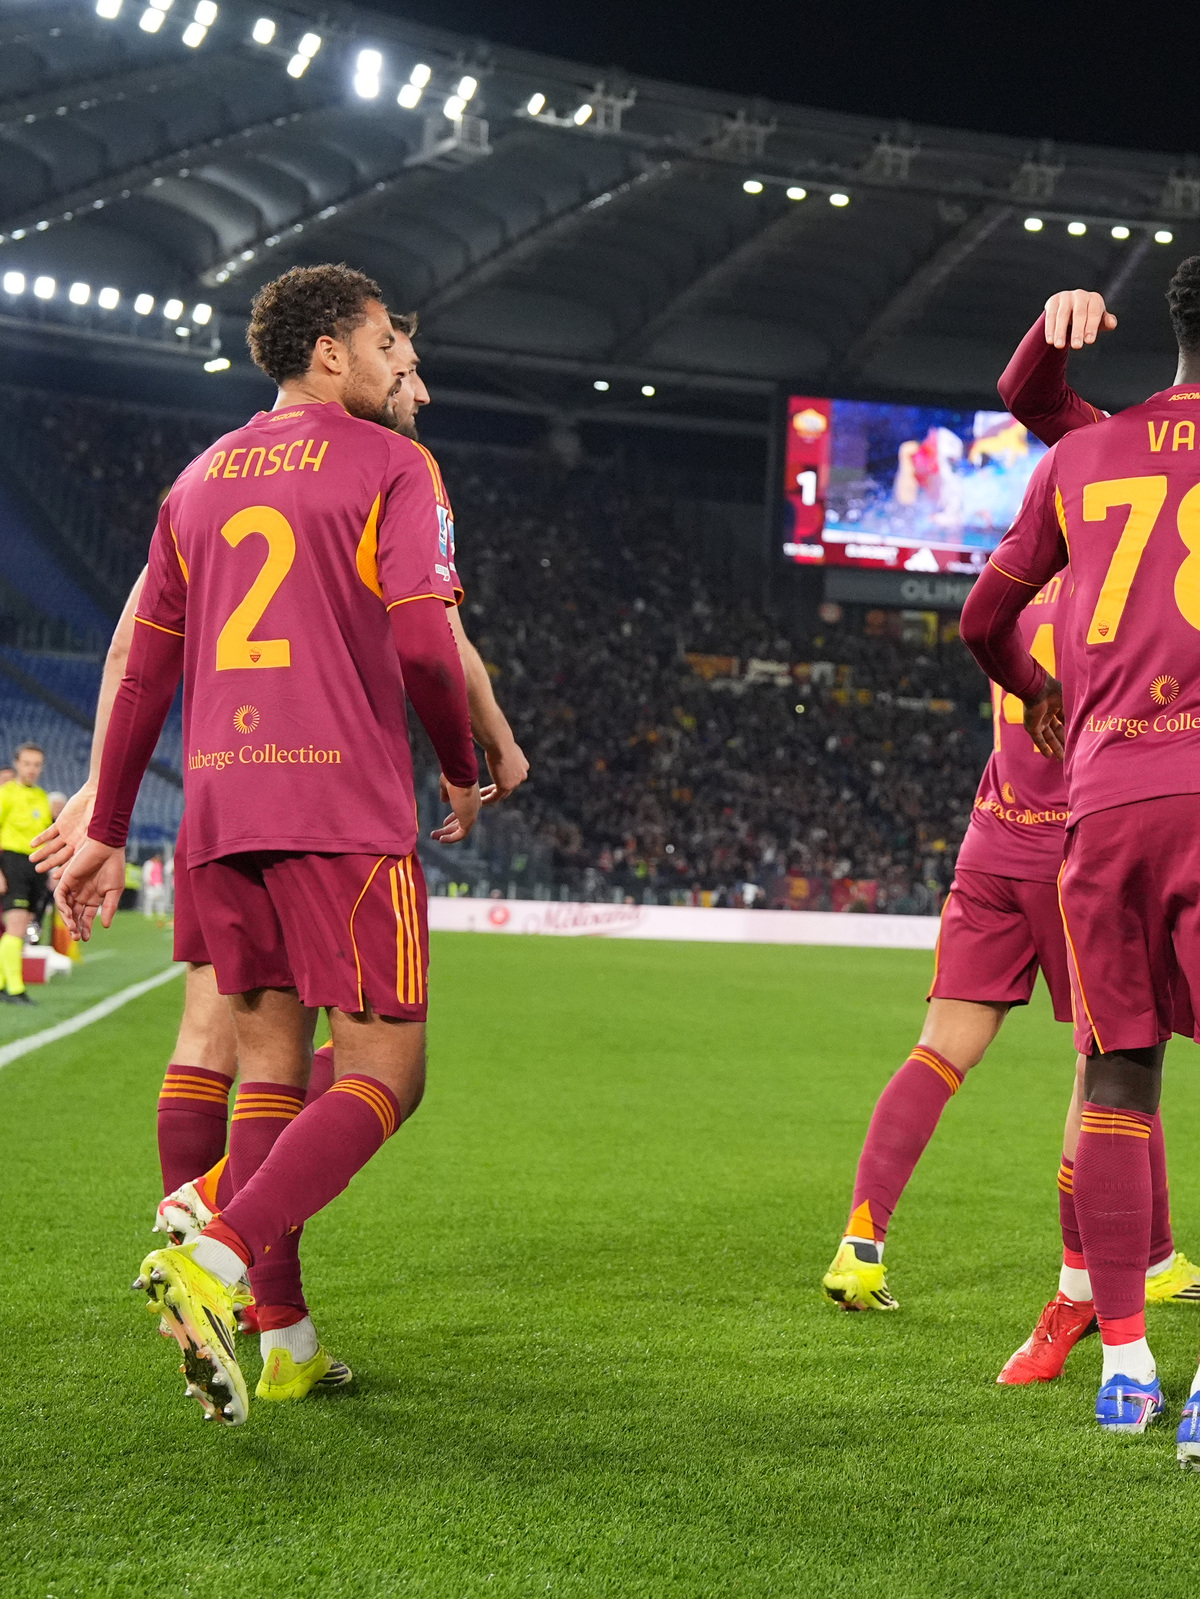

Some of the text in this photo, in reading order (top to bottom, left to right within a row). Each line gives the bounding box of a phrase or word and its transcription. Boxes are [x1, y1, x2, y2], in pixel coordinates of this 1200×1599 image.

[203, 439, 329, 482] RENSCH
[796, 471, 817, 506] 1
[215, 505, 296, 671] 2
[238, 743, 342, 765] Collection
